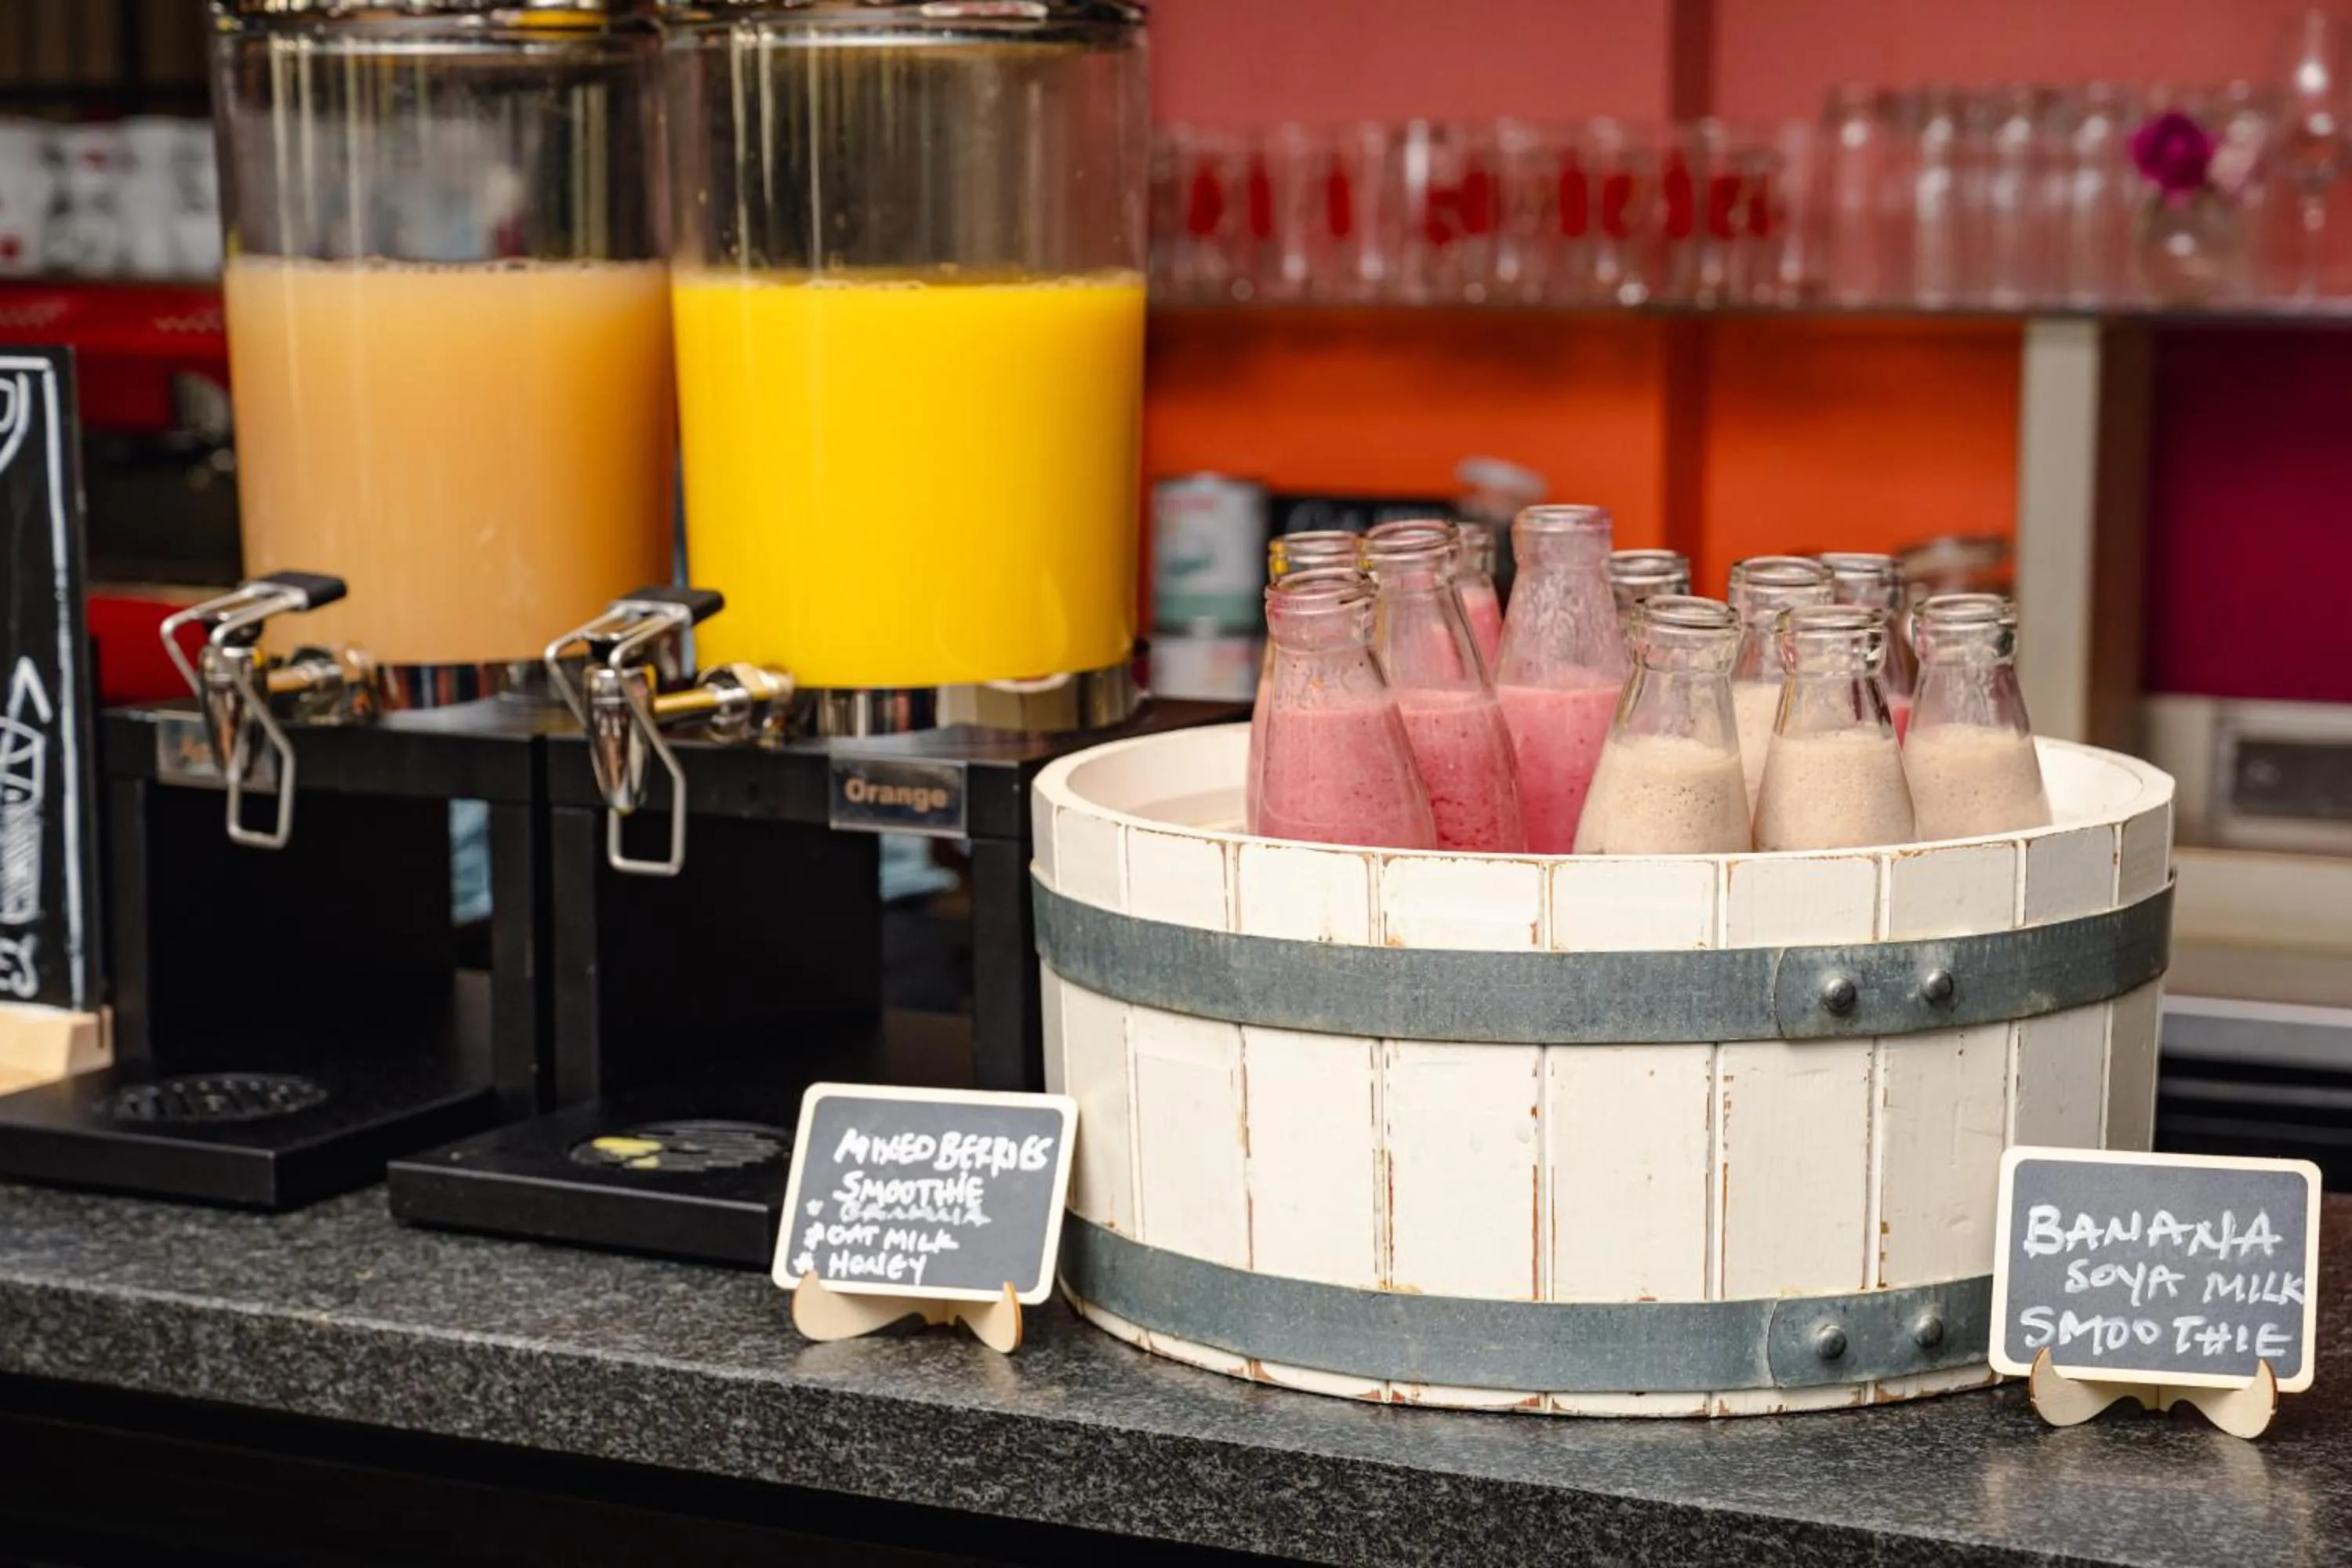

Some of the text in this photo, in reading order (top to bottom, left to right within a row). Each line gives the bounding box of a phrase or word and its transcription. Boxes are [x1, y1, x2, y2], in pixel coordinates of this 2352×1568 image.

[844, 777, 948, 814] Orange
[831, 1169, 985, 1208] SMOOTHIE
[826, 1222, 960, 1254] OAT MILK
[2023, 1203, 2283, 1260] BANANA
[827, 1248, 928, 1286] HONEY
[2064, 1258, 2306, 1307] SOYA MILK
